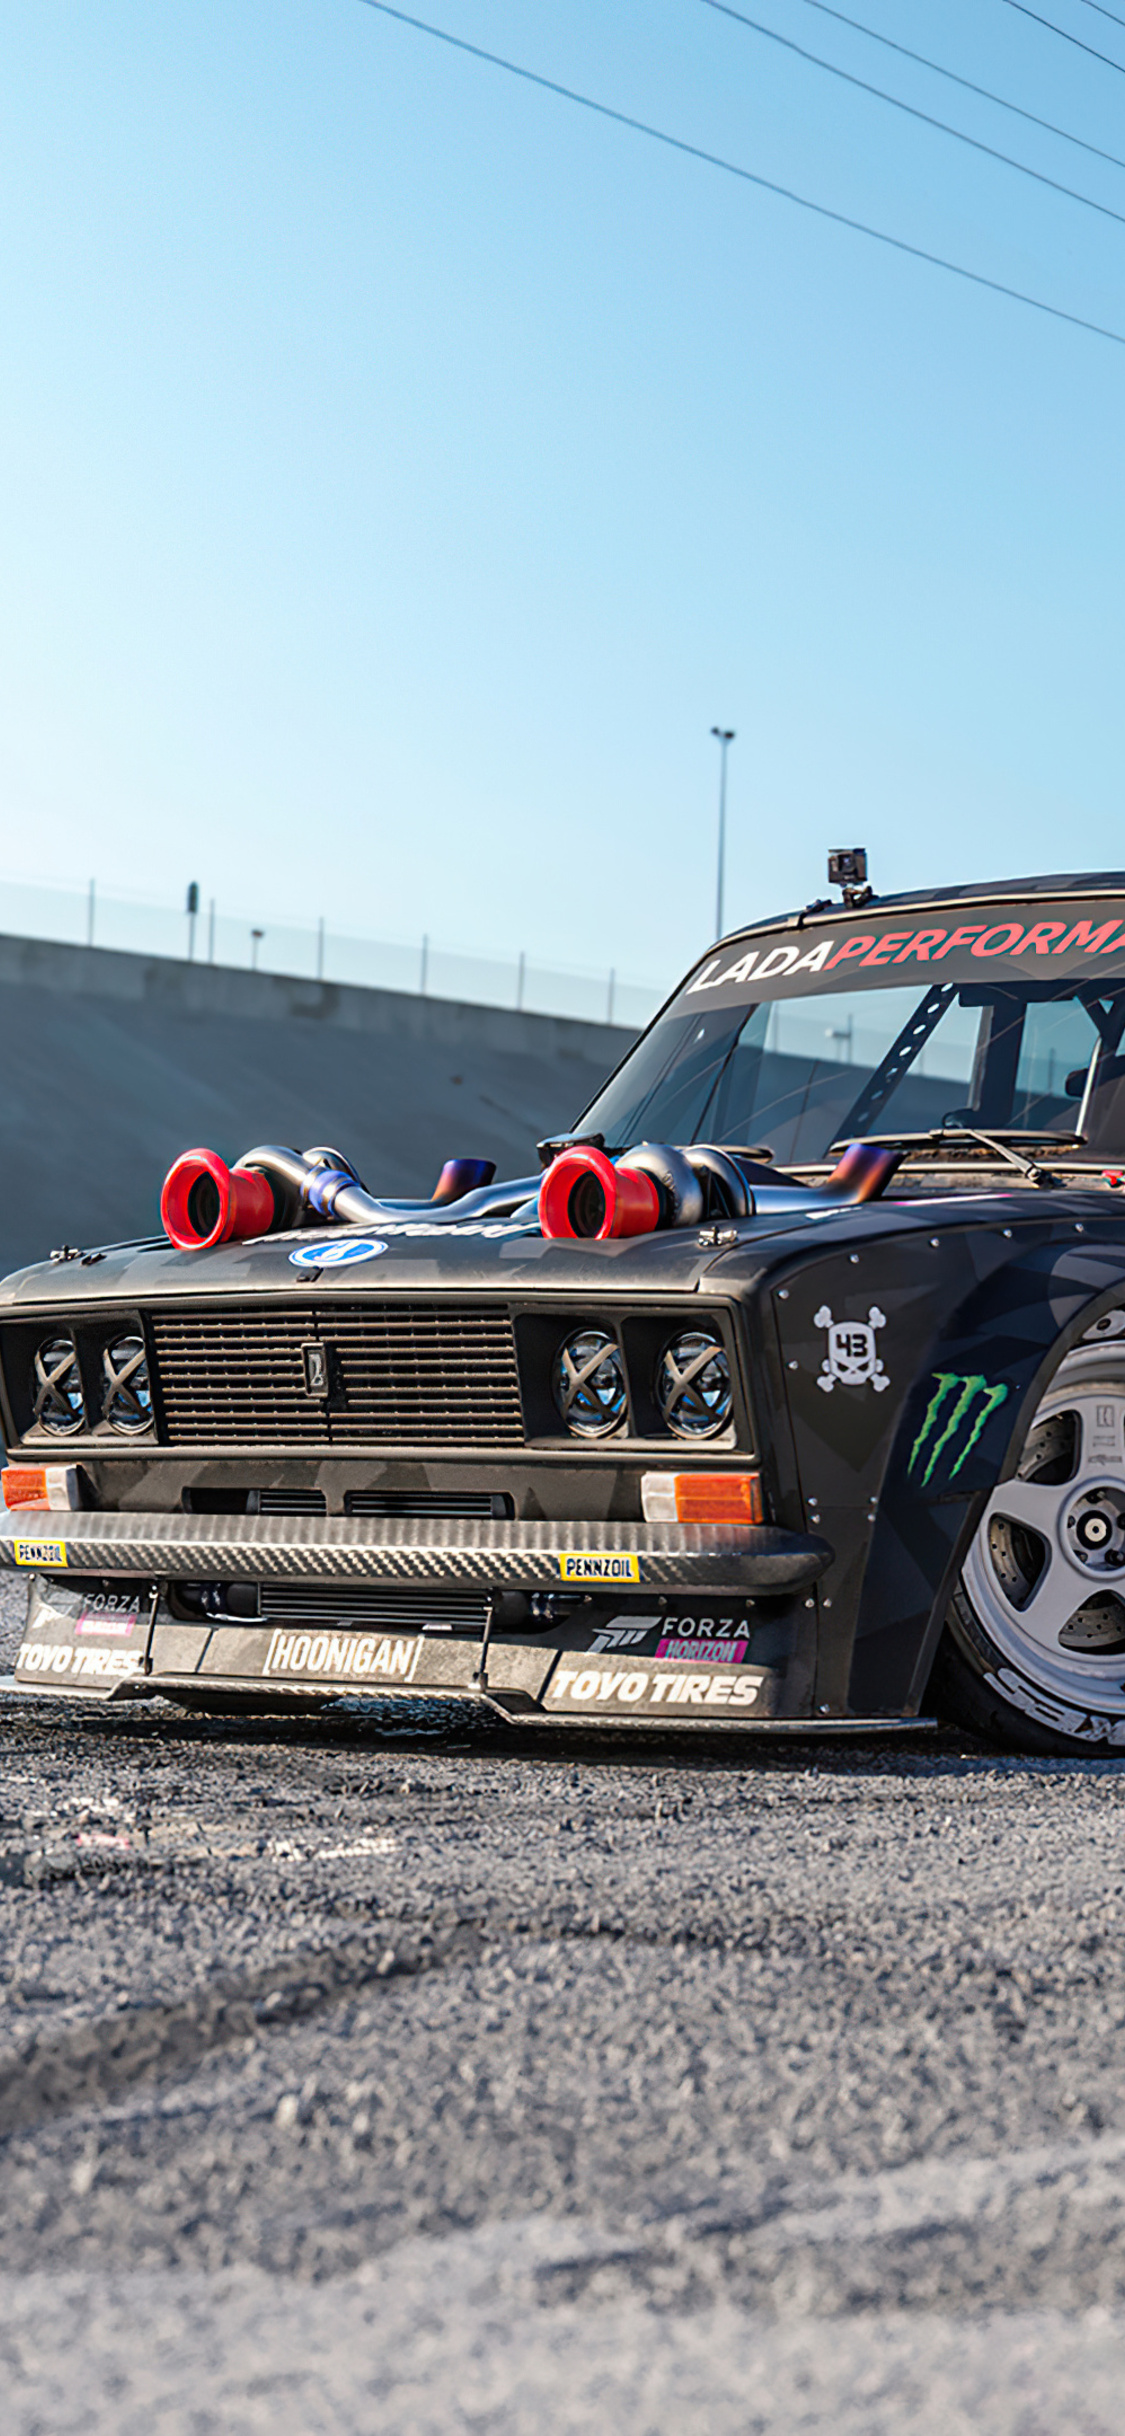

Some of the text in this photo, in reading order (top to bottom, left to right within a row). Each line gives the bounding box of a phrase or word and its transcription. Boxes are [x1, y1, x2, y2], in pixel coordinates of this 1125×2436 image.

[835, 1333, 868, 1358] 43
[566, 1558, 633, 1577] PENNZOIL
[83, 1593, 140, 1613] FORZA
[662, 1616, 750, 1638] FORZA
[15, 1643, 146, 1677] TOYO TIRES
[664, 1640, 738, 1662] HORIZON
[552, 1671, 763, 1705] TOYO TIRES
